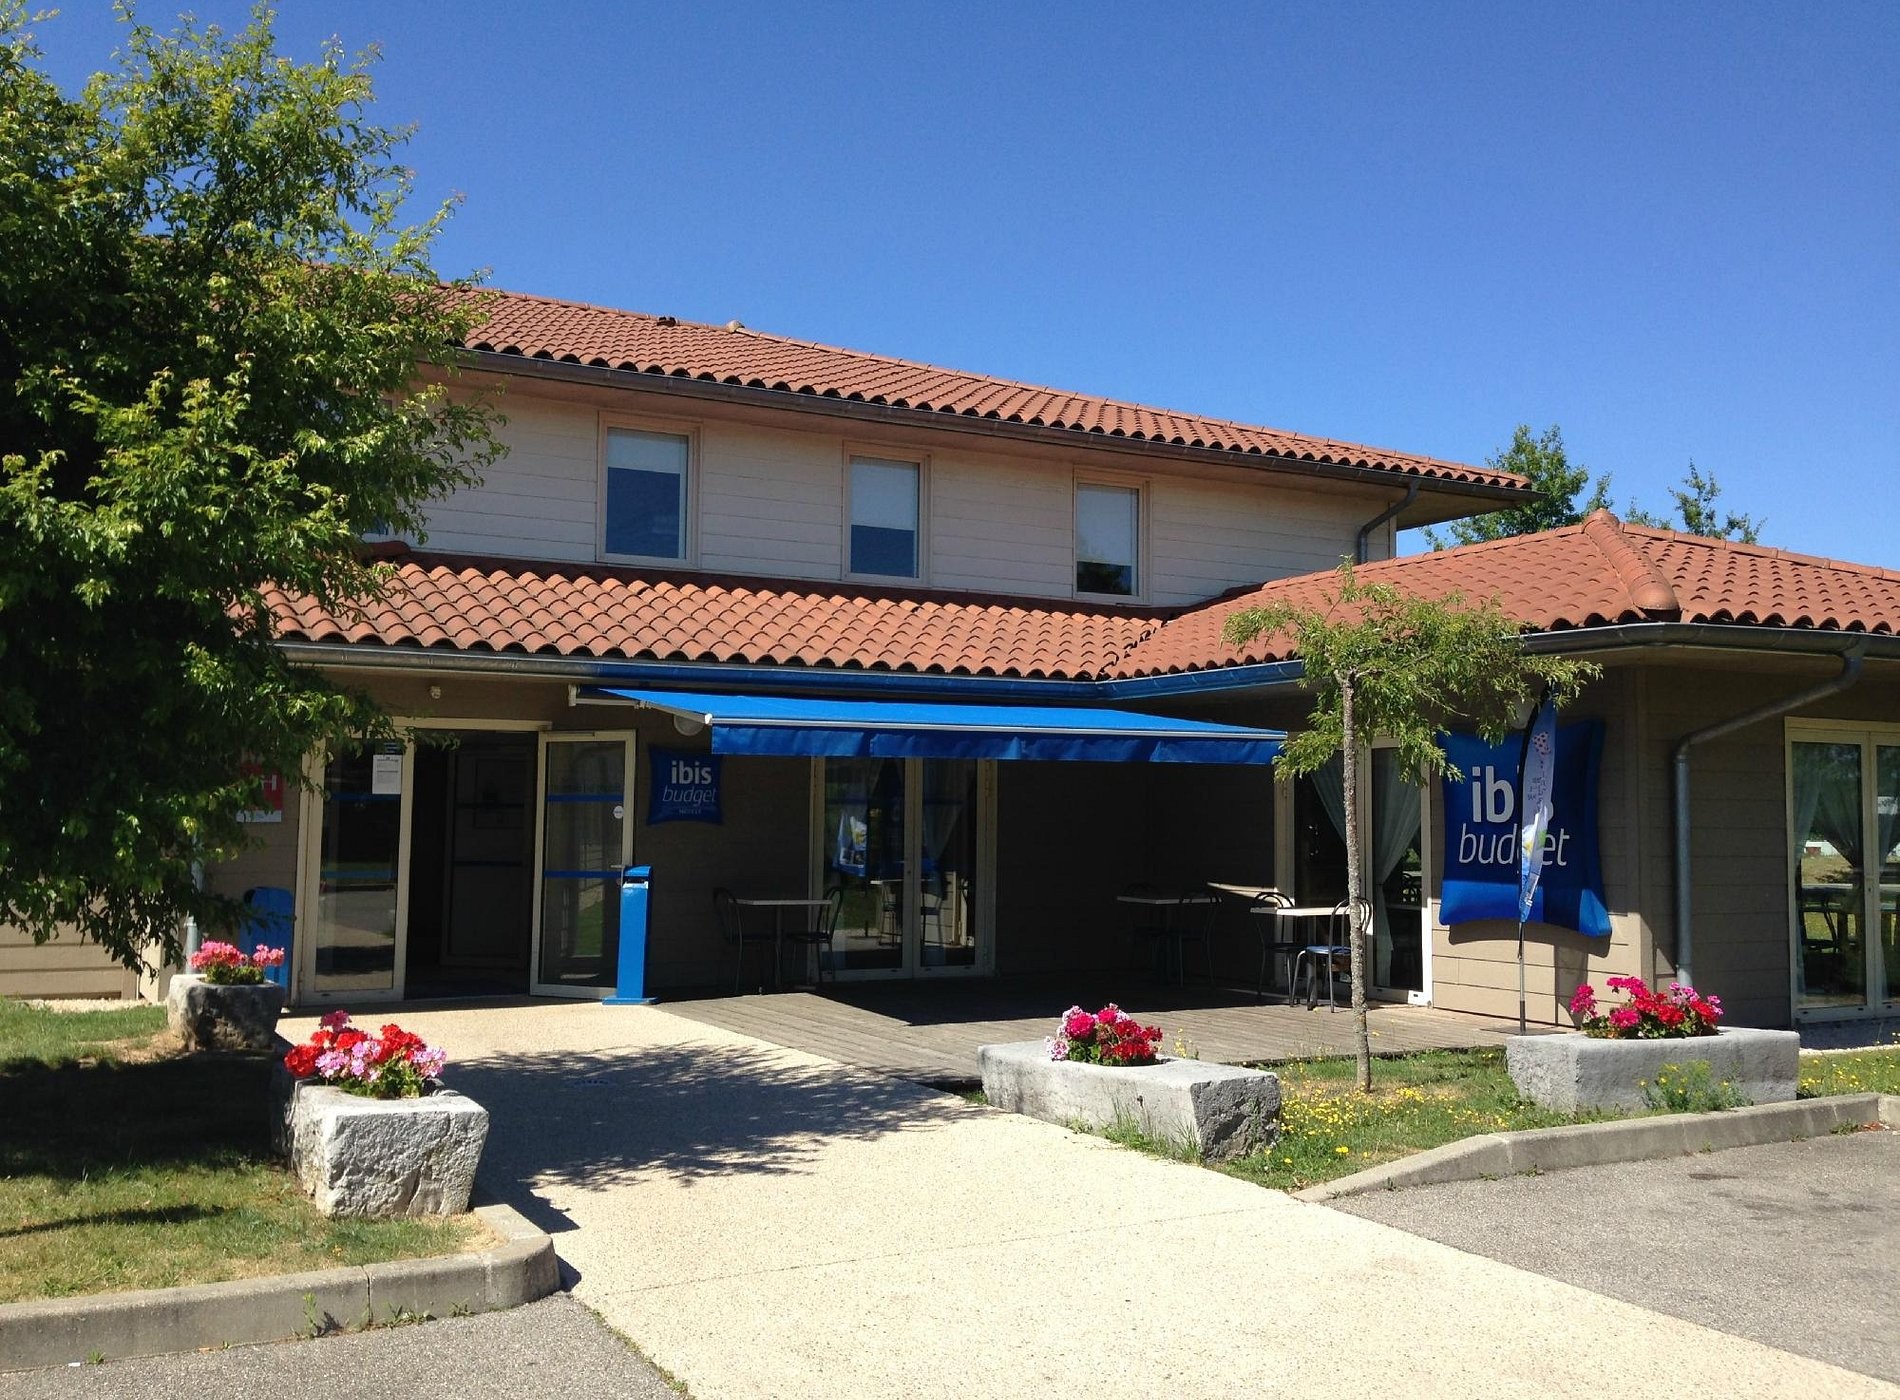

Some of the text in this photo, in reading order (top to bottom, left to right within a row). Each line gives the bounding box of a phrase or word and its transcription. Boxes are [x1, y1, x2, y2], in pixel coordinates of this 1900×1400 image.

[671, 760, 712, 785] ibis
[662, 784, 717, 807] budget
[1471, 765, 1554, 823] ib
[1458, 822, 1570, 874] budet
